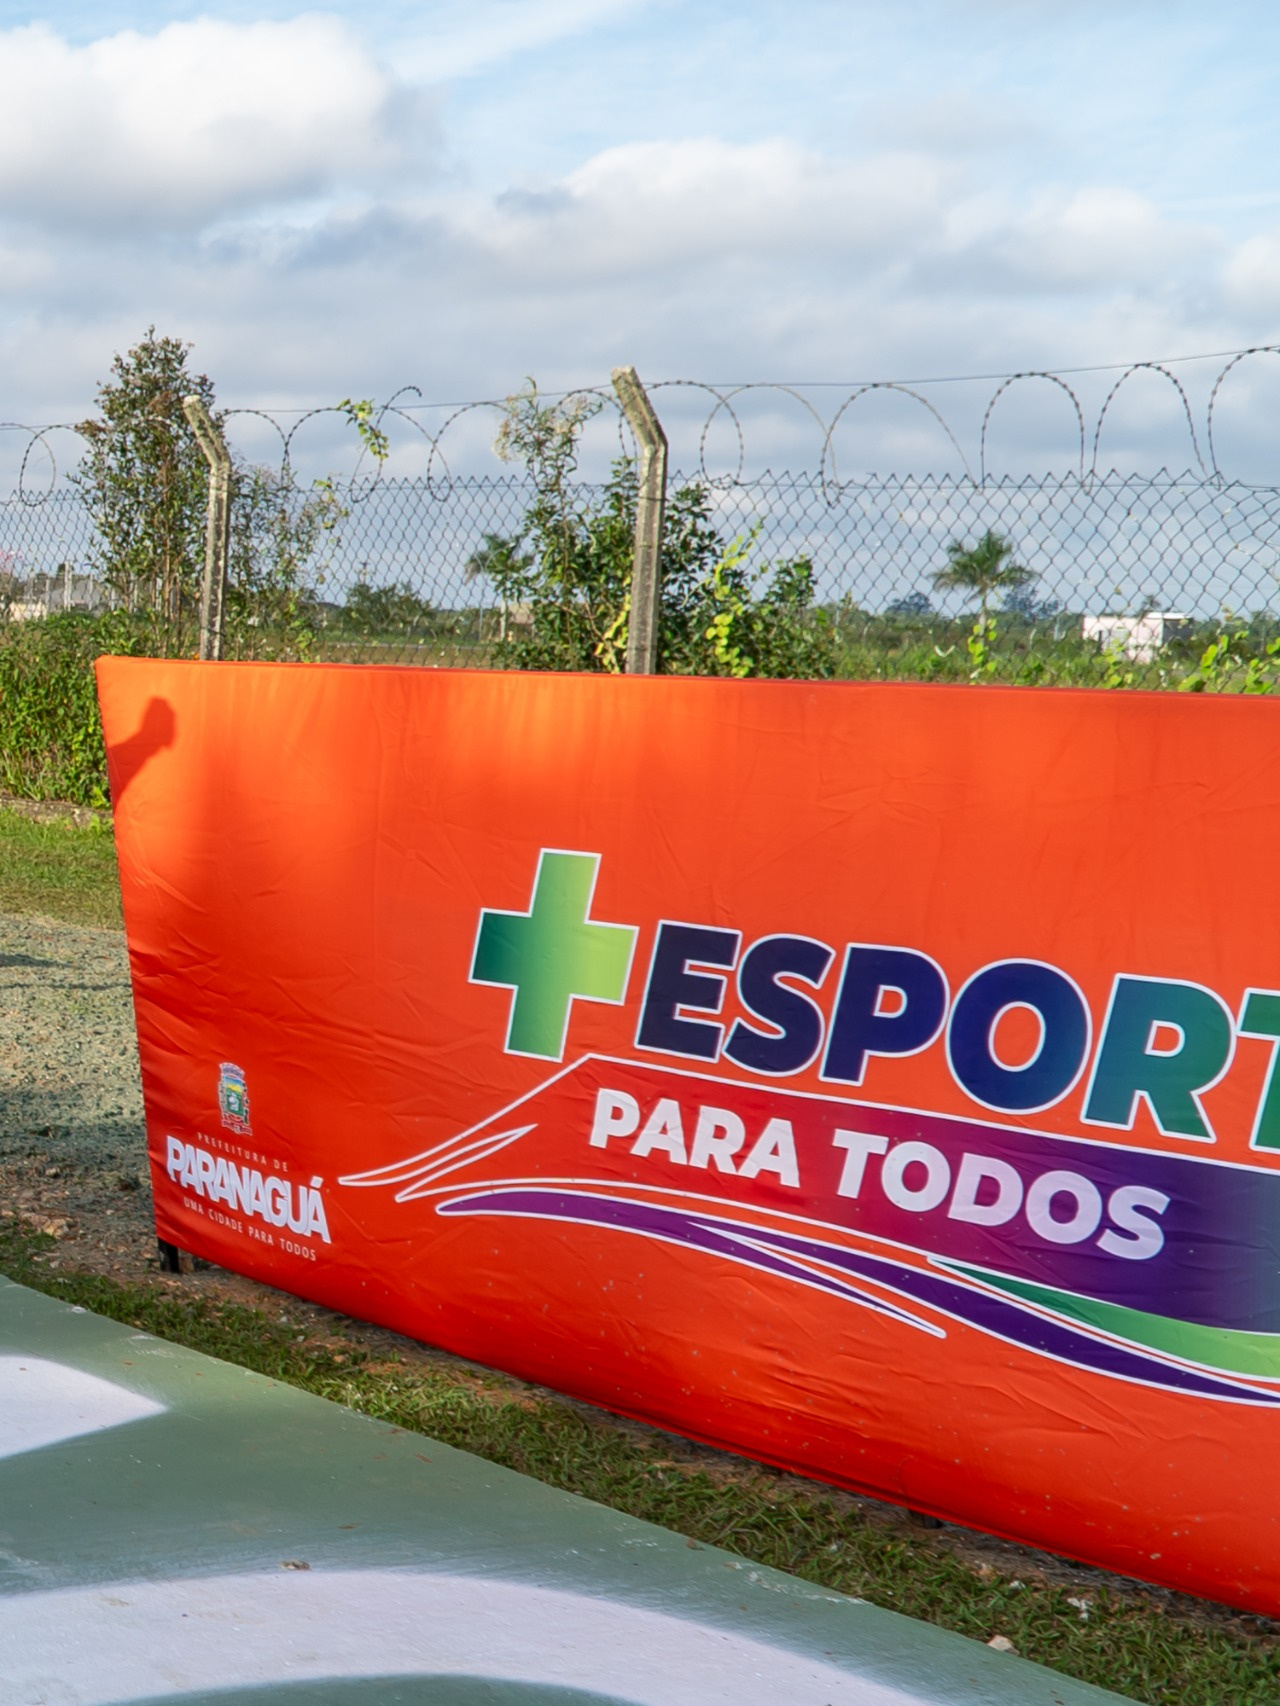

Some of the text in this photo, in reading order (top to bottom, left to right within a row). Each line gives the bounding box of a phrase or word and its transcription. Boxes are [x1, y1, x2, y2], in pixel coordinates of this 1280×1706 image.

[167, 1135, 332, 1244] PARANAGUÁ
[198, 1131, 288, 1172] PREFEITURA DE
[589, 1087, 1171, 1260] PARA TODOS
[183, 1197, 317, 1261] UMA CIDADE PARA TODOS
